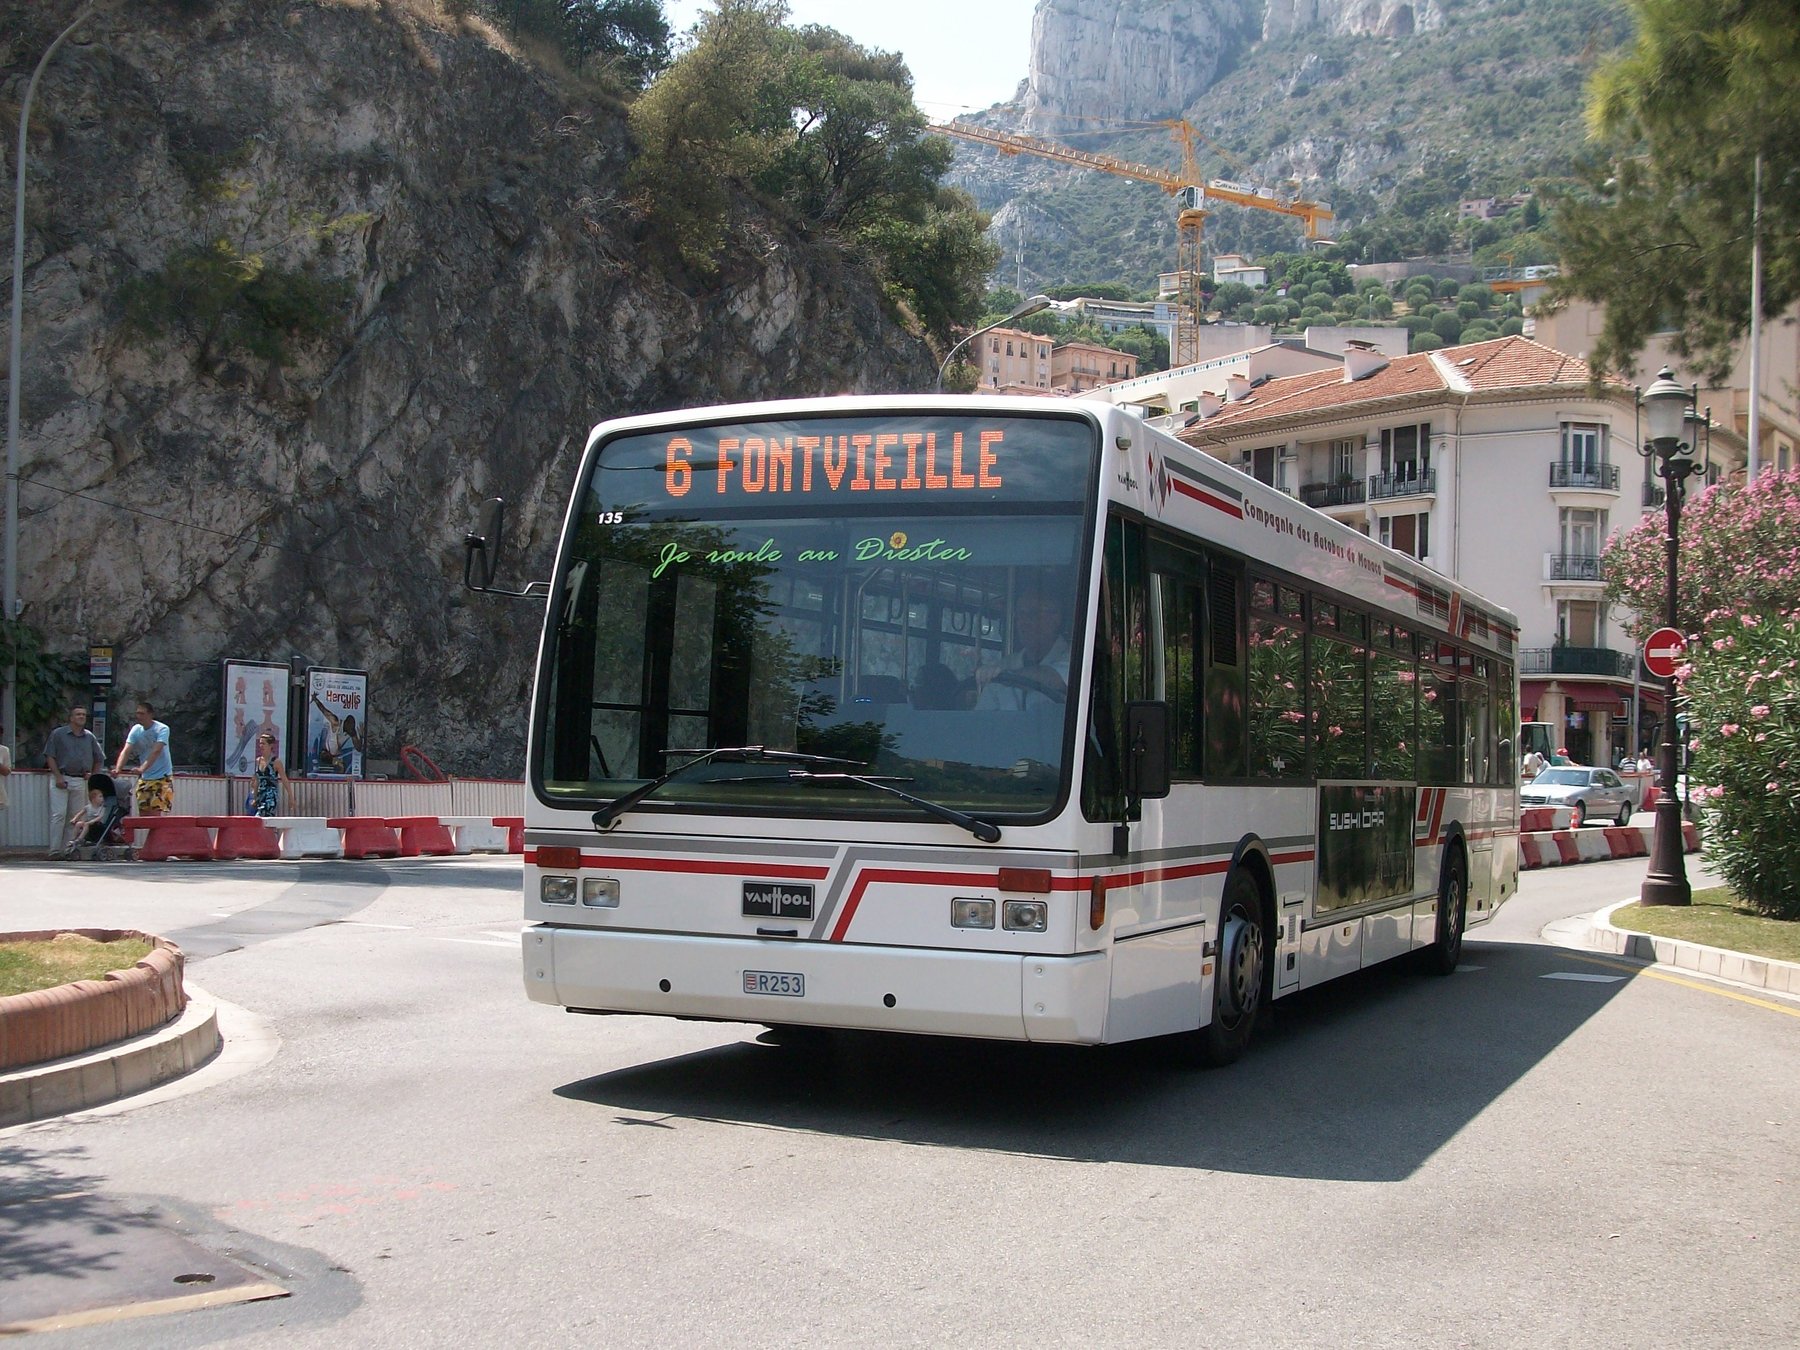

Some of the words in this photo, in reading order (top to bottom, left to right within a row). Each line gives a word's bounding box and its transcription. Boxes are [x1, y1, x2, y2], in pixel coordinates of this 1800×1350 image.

[665, 438, 693, 497] 6
[717, 431, 1004, 493] FONTVIEILLE
[598, 511, 624, 525] 135
[1244, 499, 1294, 535] Compagnie
[1297, 523, 1310, 543] des
[1313, 531, 1344, 559] Autobus
[1346, 547, 1355, 563] de
[1358, 551, 1382, 575] Monaco
[652, 542, 691, 579] Je
[706, 537, 783, 563] roule
[798, 548, 840, 562] au
[855, 535, 974, 562] Diester
[326, 690, 361, 704] Herculis
[1329, 812, 1361, 830] SUSHI
[759, 974, 801, 994] R253
